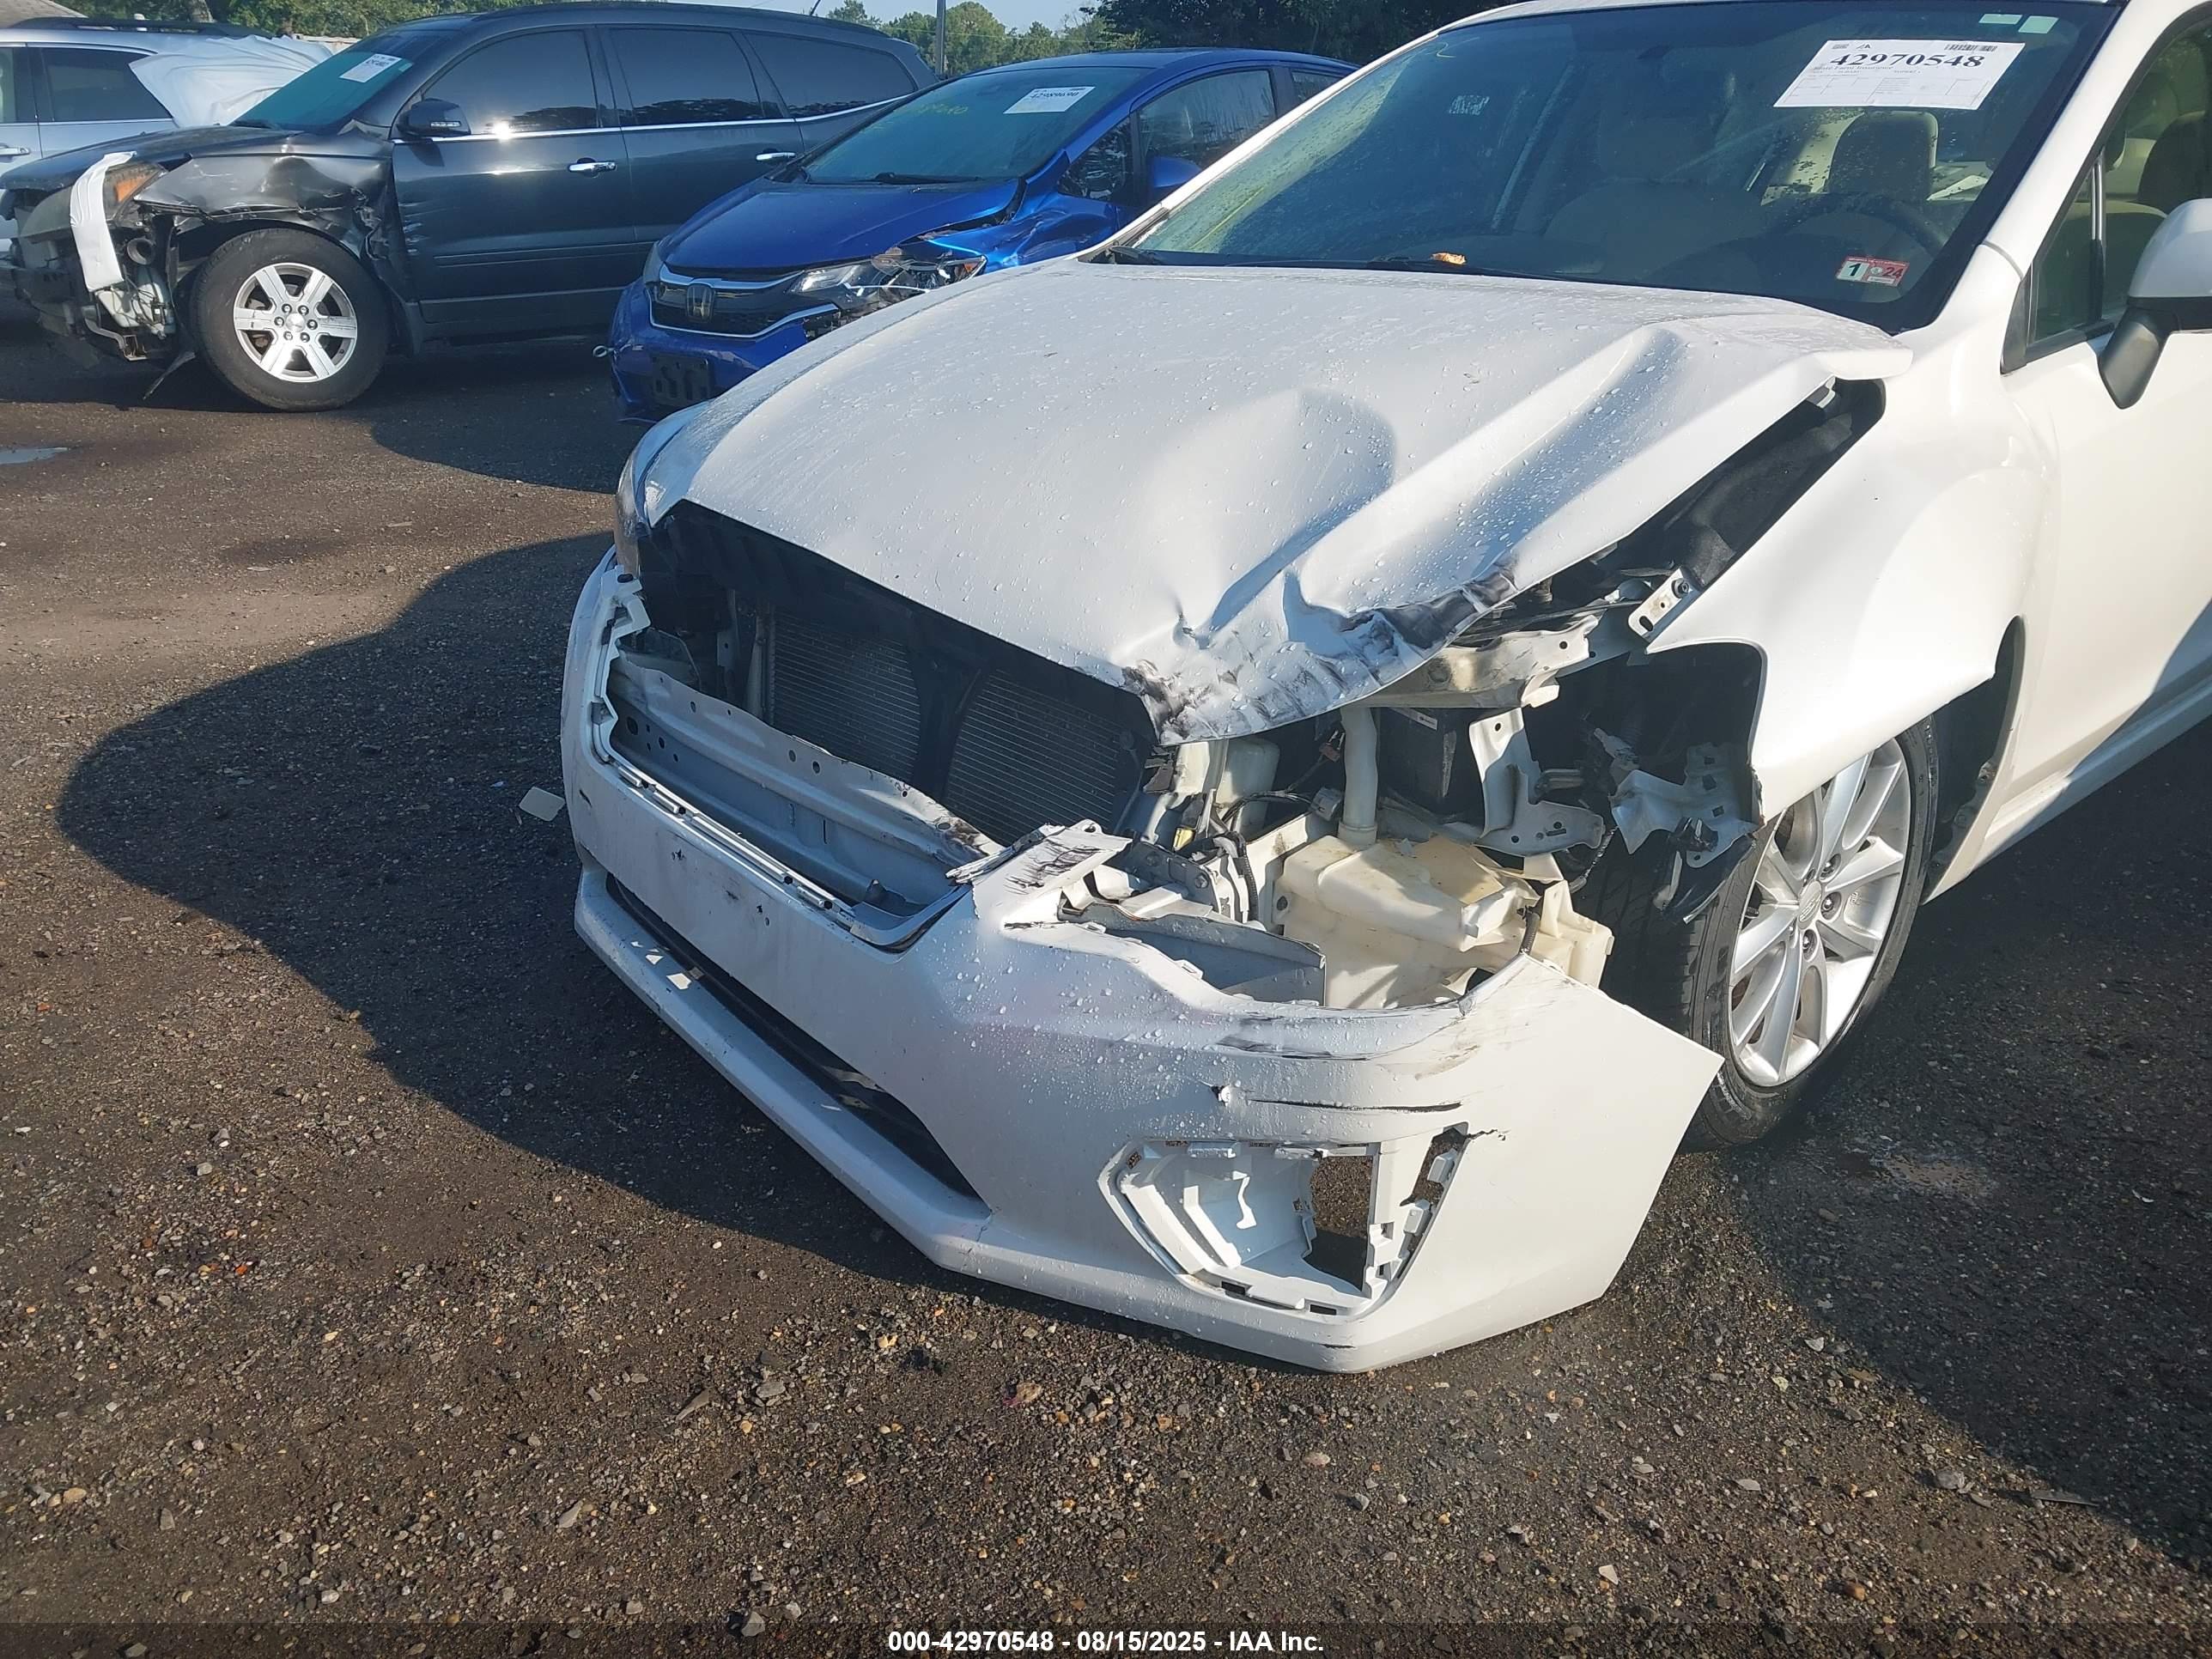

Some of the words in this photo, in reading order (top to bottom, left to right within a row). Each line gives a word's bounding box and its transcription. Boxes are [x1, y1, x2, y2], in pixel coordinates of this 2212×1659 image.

[1830, 53, 1985, 68] 42970548
[1849, 263, 1862, 276] 1
[1881, 267, 1904, 279] 24
